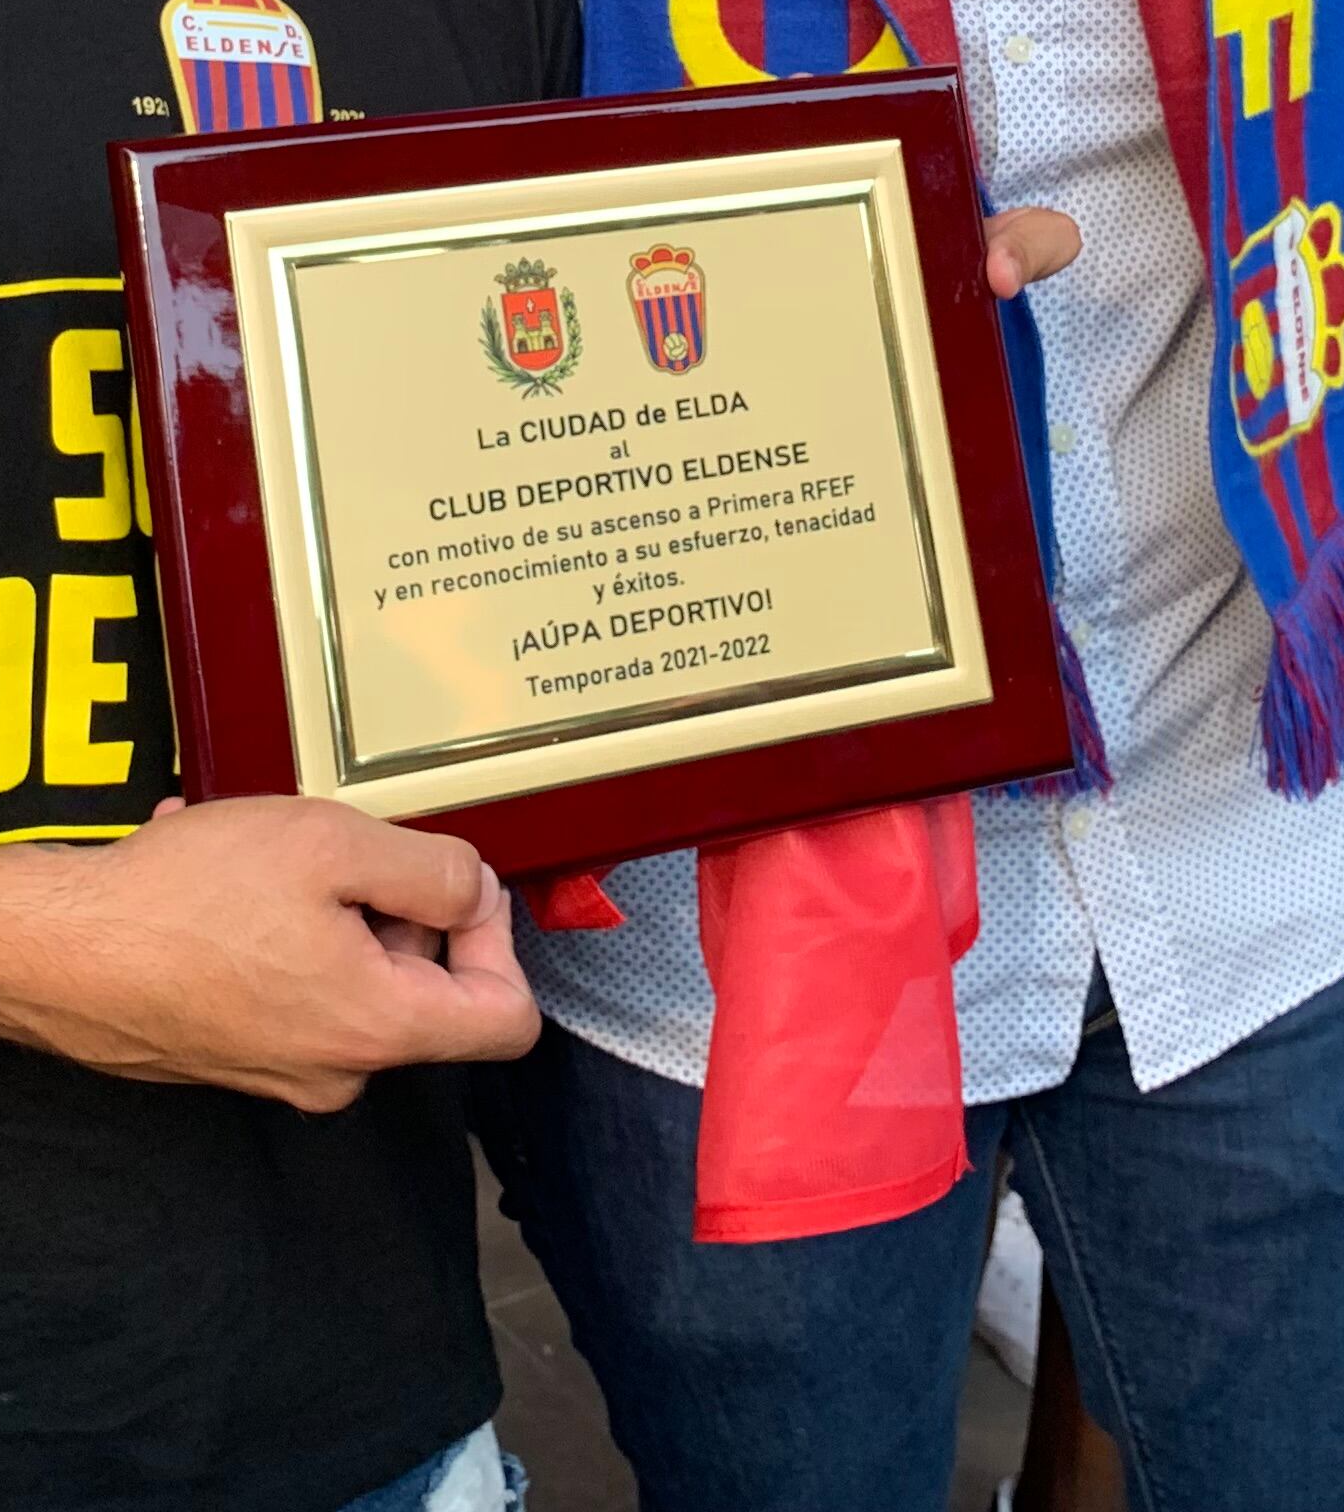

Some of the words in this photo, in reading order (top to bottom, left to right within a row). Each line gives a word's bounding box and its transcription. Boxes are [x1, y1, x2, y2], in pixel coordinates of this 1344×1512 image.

[185, 36, 305, 59] ELDENSE
[477, 428, 511, 450] La
[520, 408, 626, 443] CIUDAD
[636, 404, 667, 426] de
[676, 391, 749, 421] ELDA
[609, 440, 631, 460] al
[429, 488, 507, 521] CLUB
[517, 463, 673, 508] DEPORTIVO
[683, 442, 810, 482] ELDENSE
[388, 548, 430, 570] con
[438, 533, 515, 562] motivo
[522, 526, 549, 548] de
[556, 523, 583, 542] su
[591, 507, 681, 536] ascenso
[688, 505, 701, 520] a
[707, 489, 794, 517] Primera
[801, 475, 855, 502] RFEF
[374, 588, 387, 610] y
[395, 582, 424, 601] en
[431, 550, 607, 596] reconocimiento
[616, 548, 628, 564] a
[635, 541, 662, 560] su
[668, 525, 770, 556] esfuerzo,
[775, 502, 876, 537] tenacidad
[593, 583, 606, 605] y
[613, 571, 685, 596] éxitos.
[512, 619, 601, 661] ¡AÚPA
[610, 588, 774, 638] DEPORTIVO!
[526, 657, 653, 697] Temporada
[660, 633, 771, 673] 2021-2022
